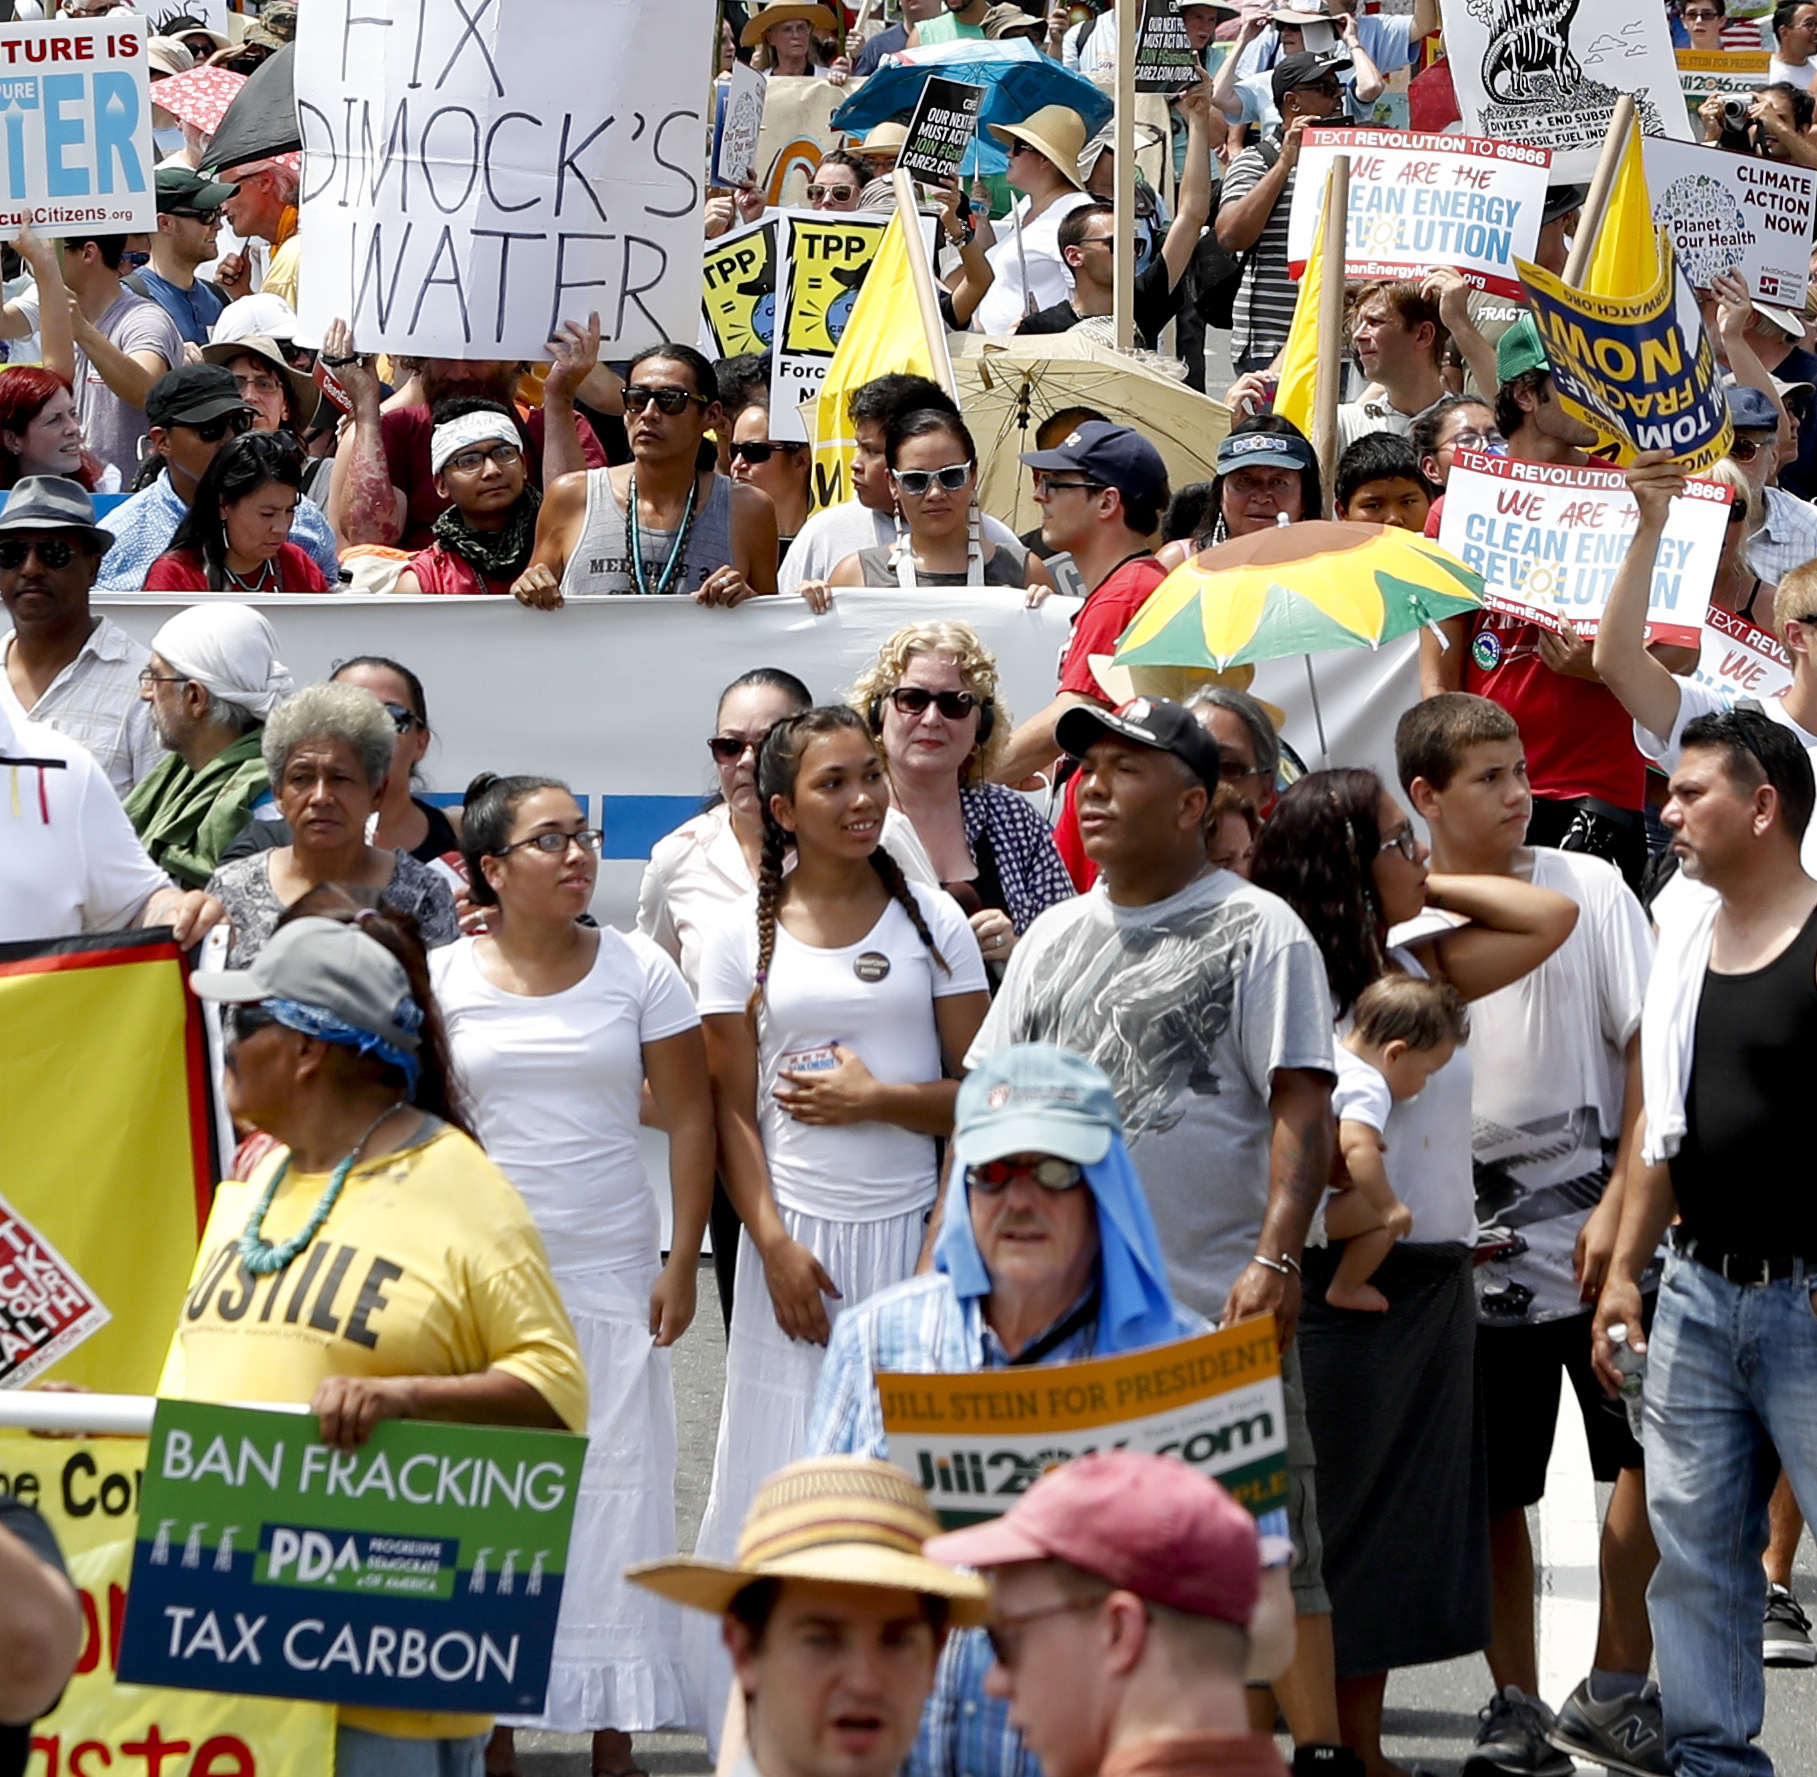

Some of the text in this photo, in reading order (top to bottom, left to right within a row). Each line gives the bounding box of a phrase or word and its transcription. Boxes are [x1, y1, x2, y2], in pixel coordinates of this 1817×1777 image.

[107, 34, 139, 58] IS
[297, 97, 699, 222] DIMOCK'S
[1736, 165, 1811, 195] CLIMATE
[1744, 189, 1809, 216] ACTION
[1674, 218, 1720, 233] Planet
[1708, 231, 1756, 246] Health
[1764, 214, 1808, 236] NOW
[802, 234, 865, 260] TPP
[352, 222, 671, 344] WATER
[951, 1383, 1108, 1422] STEIN FOR
[161, 1429, 566, 1513] BAN FRACKING
[164, 1605, 520, 1684] TAX CARBON
